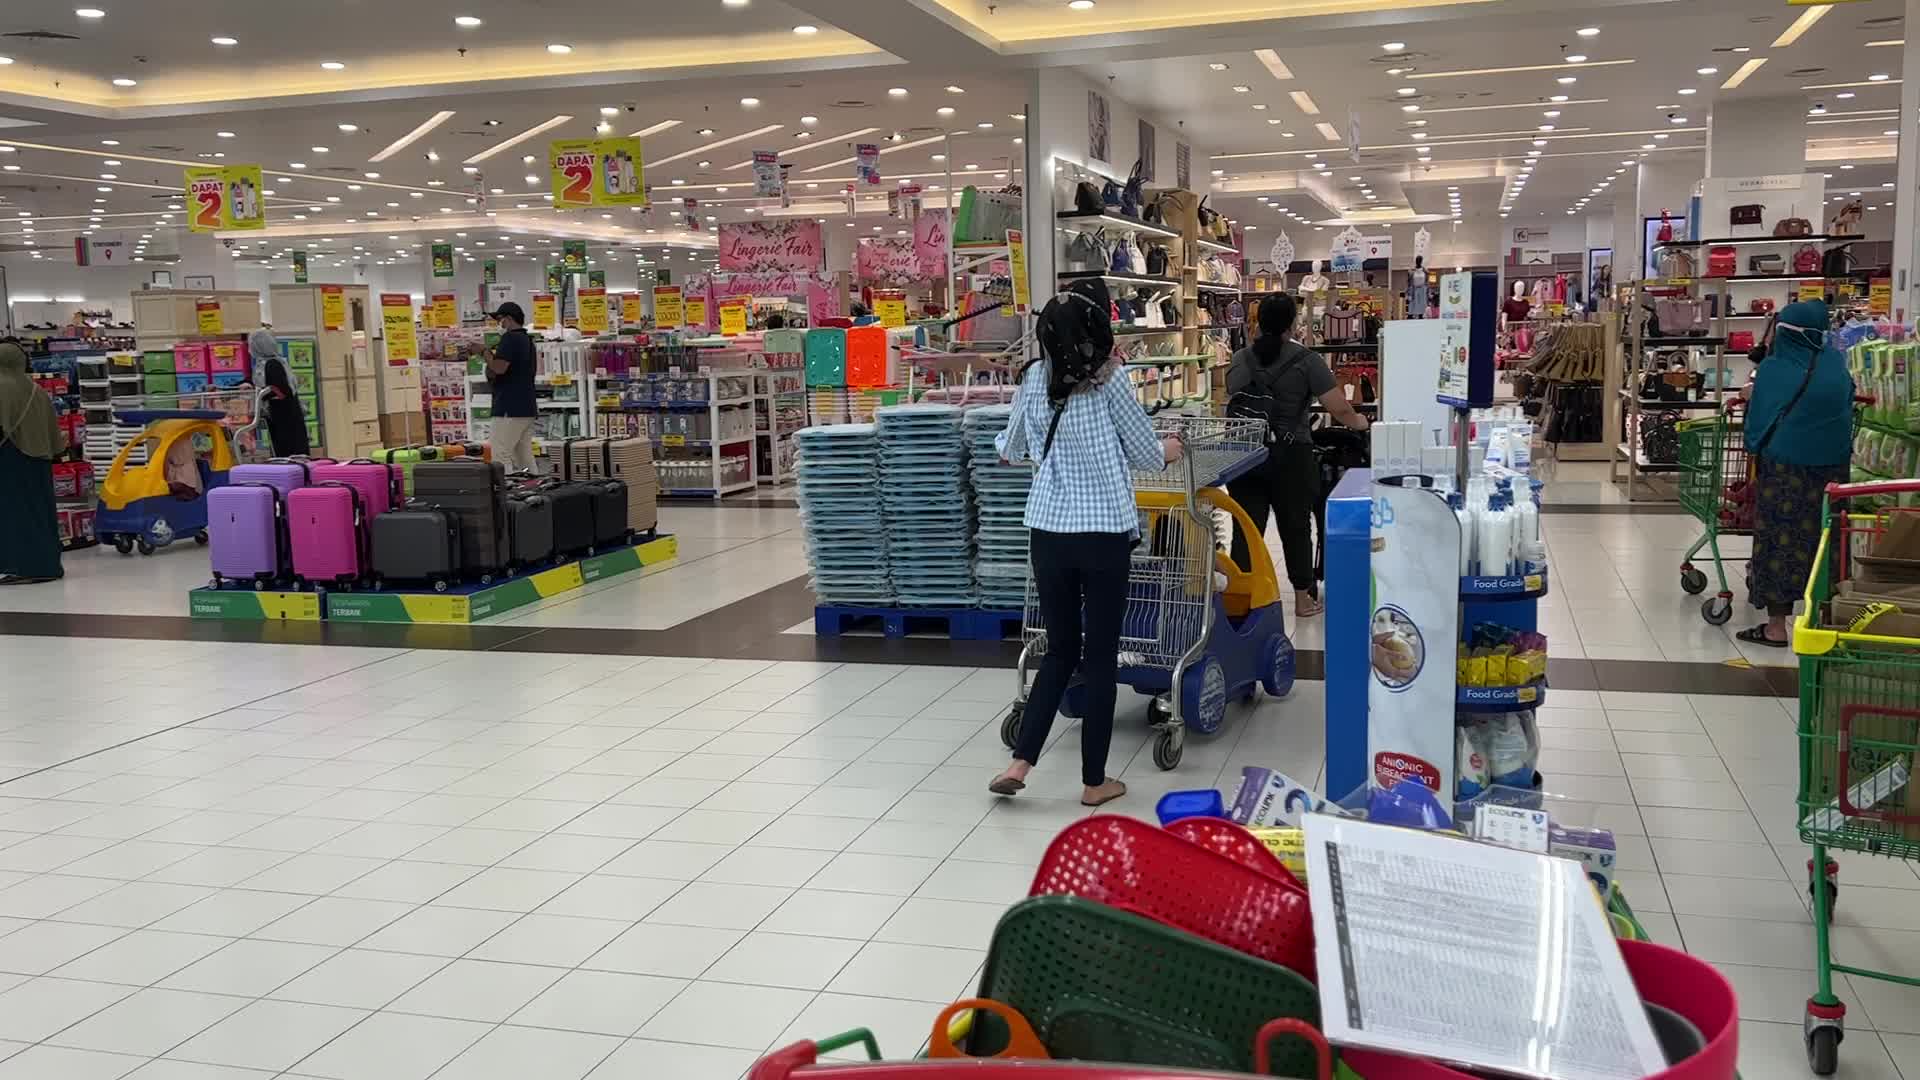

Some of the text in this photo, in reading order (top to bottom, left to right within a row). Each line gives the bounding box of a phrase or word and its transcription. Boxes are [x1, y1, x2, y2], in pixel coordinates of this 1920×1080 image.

[557, 154, 596, 166] DAPAT
[191, 182, 224, 193] DAPAT
[562, 166, 593, 204] 2
[197, 192, 222, 227] 2
[727, 235, 815, 260] Lingerie Fair
[773, 275, 799, 292] Fair
[1473, 579, 1498, 588] Food
[332, 608, 361, 616] TERBAIK
[1466, 689, 1491, 698] Food
[1382, 755, 1424, 774] ANIONIC
[1488, 806, 1527, 818] ECOLINK
